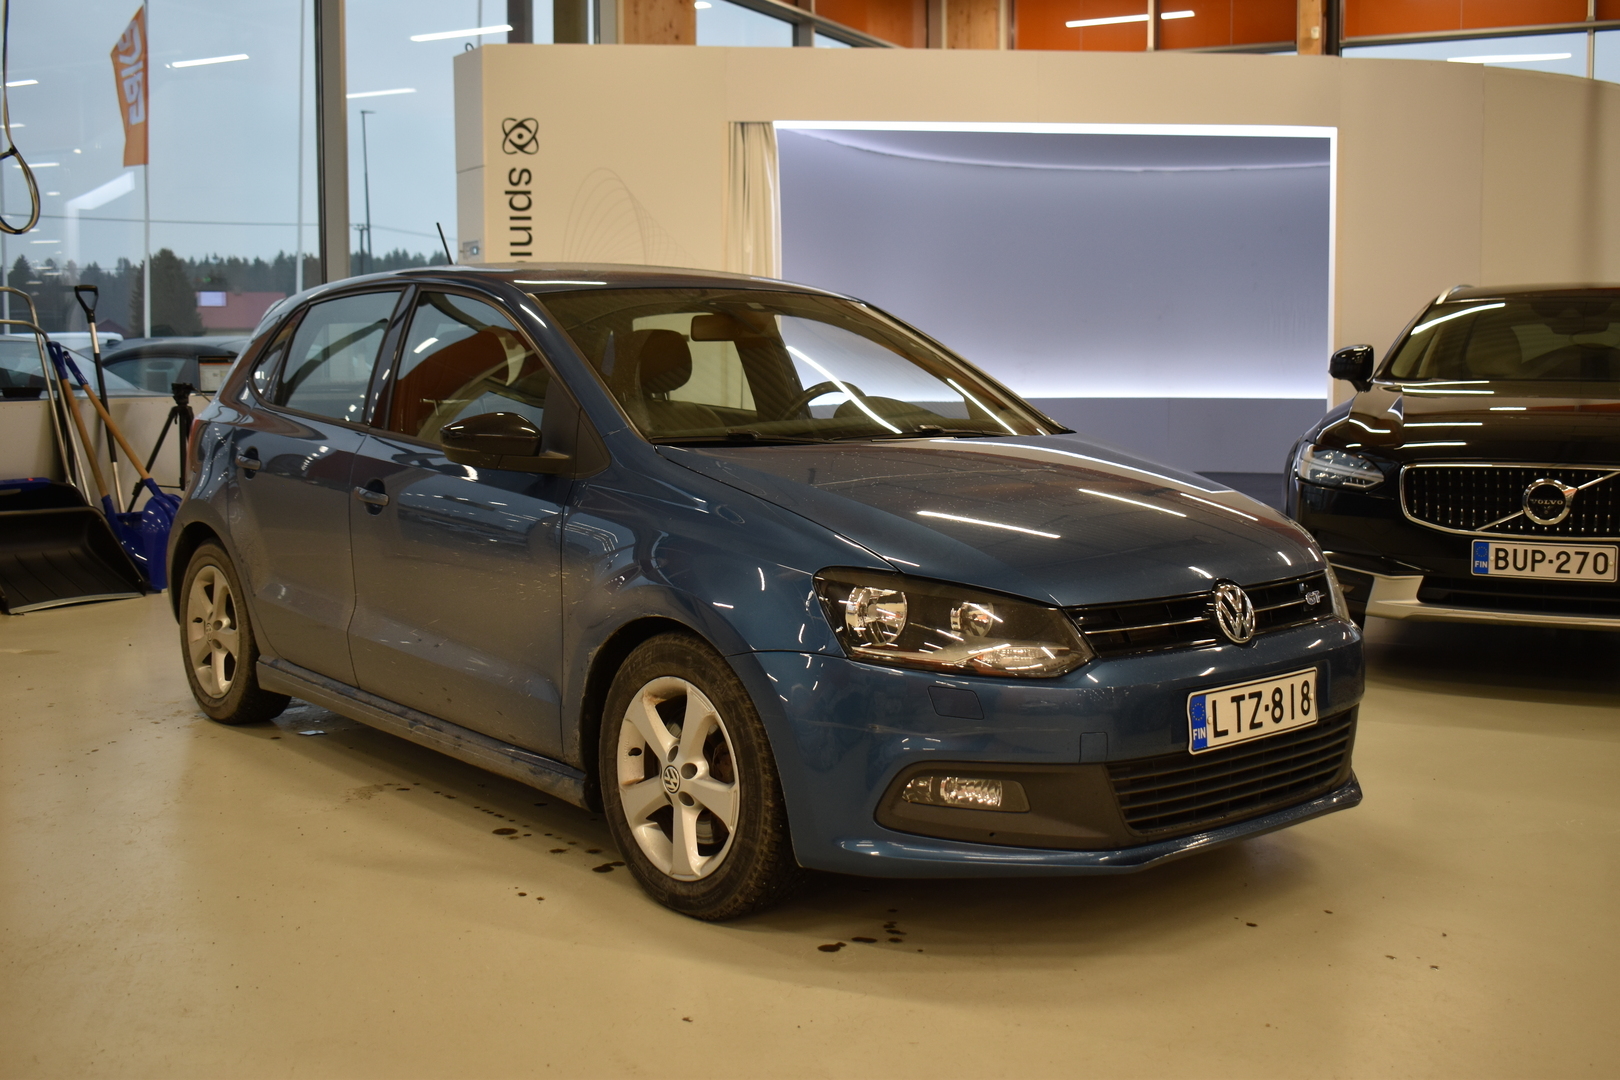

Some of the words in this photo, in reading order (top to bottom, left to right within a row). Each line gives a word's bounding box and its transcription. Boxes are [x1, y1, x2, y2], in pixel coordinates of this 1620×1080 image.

[1474, 560, 1488, 569] FIN
[1493, 547, 1609, 576] BUP-270
[1192, 726, 1206, 740] FIN
[1211, 679, 1311, 739] LTZ-818
